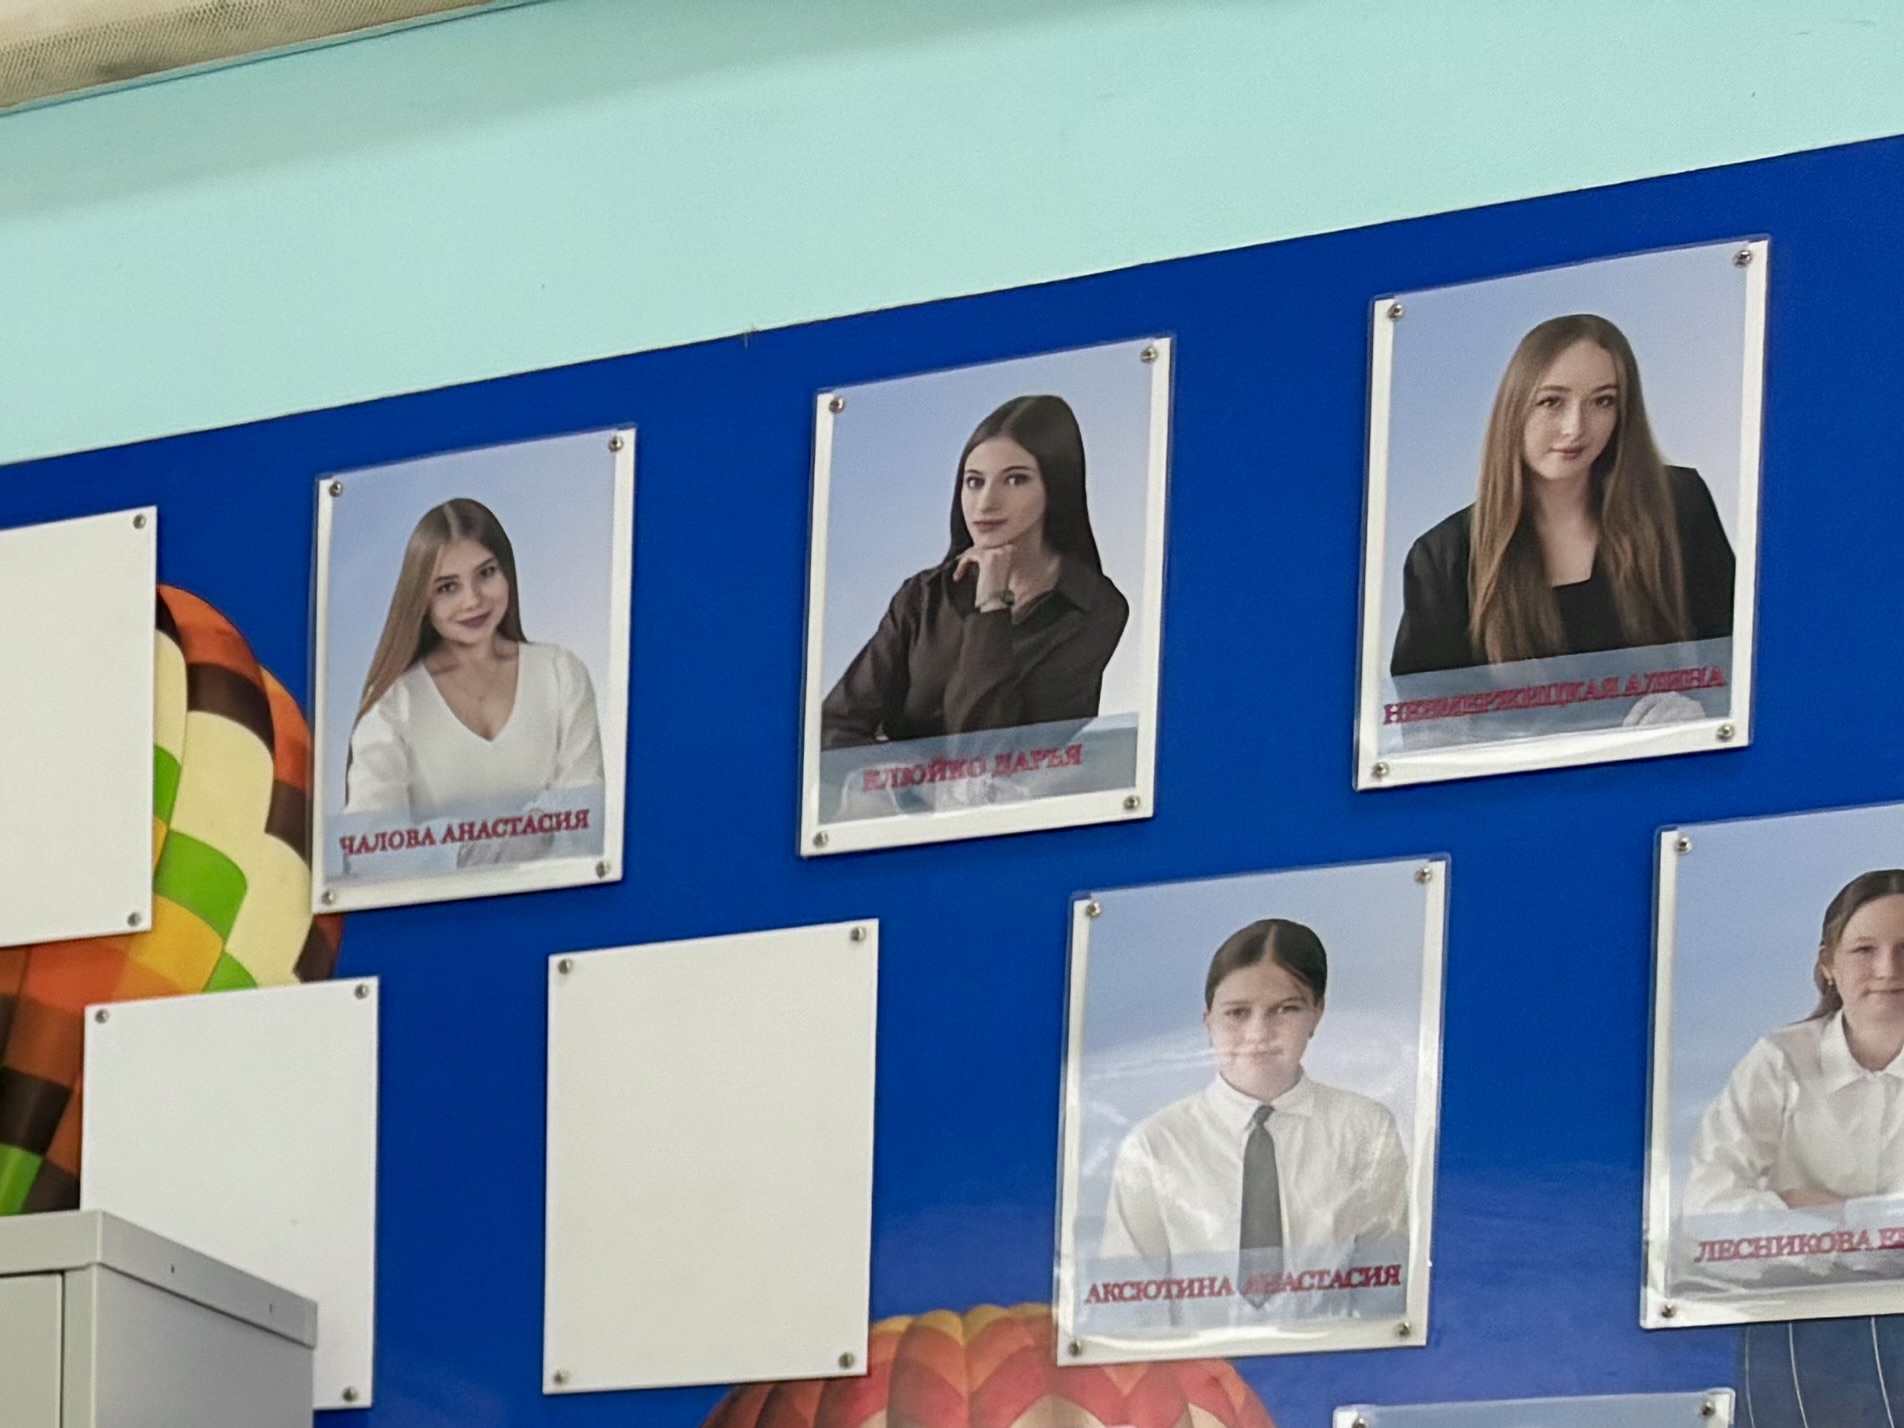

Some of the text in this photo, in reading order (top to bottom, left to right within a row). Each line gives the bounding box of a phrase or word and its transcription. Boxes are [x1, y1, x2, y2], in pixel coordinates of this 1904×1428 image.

[1623, 665, 1726, 699] АЛИНА
[992, 743, 1084, 778] ДАРЬЯ
[339, 808, 591, 856] ЧАЛОВА АНАСТАСИЯ
[1694, 1229, 1872, 1263] ЛЕСНИКОВА
[1085, 1264, 1402, 1304] АКСЮТИНА АНАСТАСИЯ
